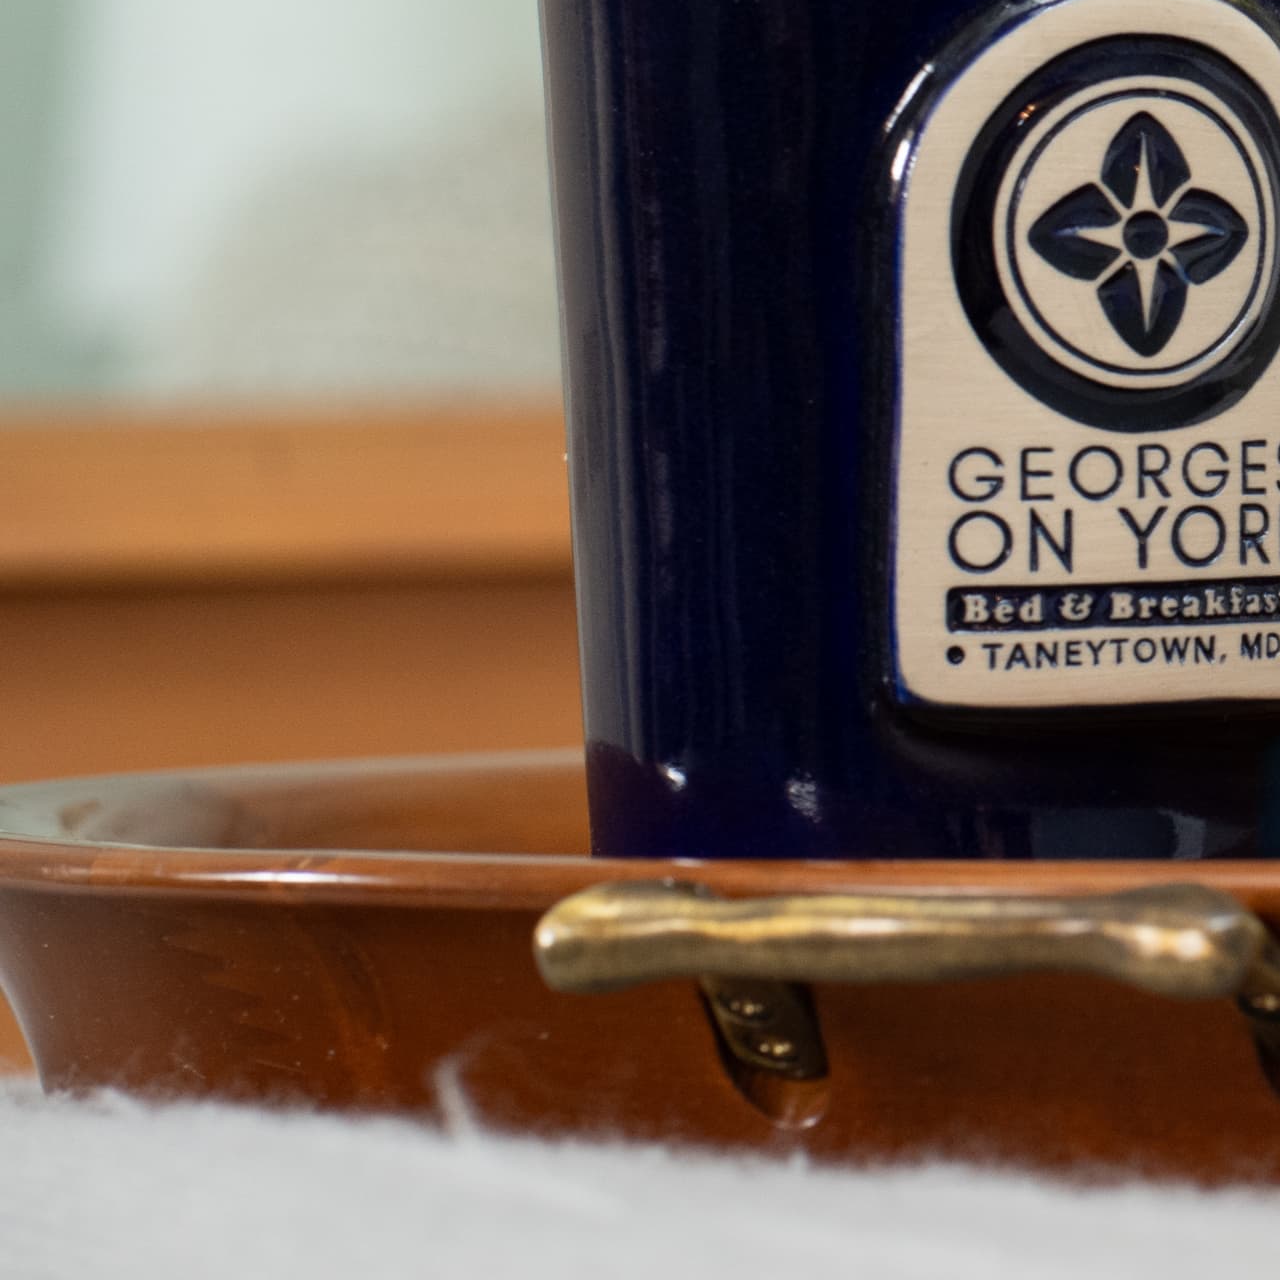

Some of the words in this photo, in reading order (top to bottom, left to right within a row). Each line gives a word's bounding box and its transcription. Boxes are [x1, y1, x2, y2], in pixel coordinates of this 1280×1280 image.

[947, 508, 1074, 574] ON
[961, 592, 1042, 624] Bed
[1060, 591, 1094, 620] &
[982, 636, 1228, 671] TANEYTOWN,
